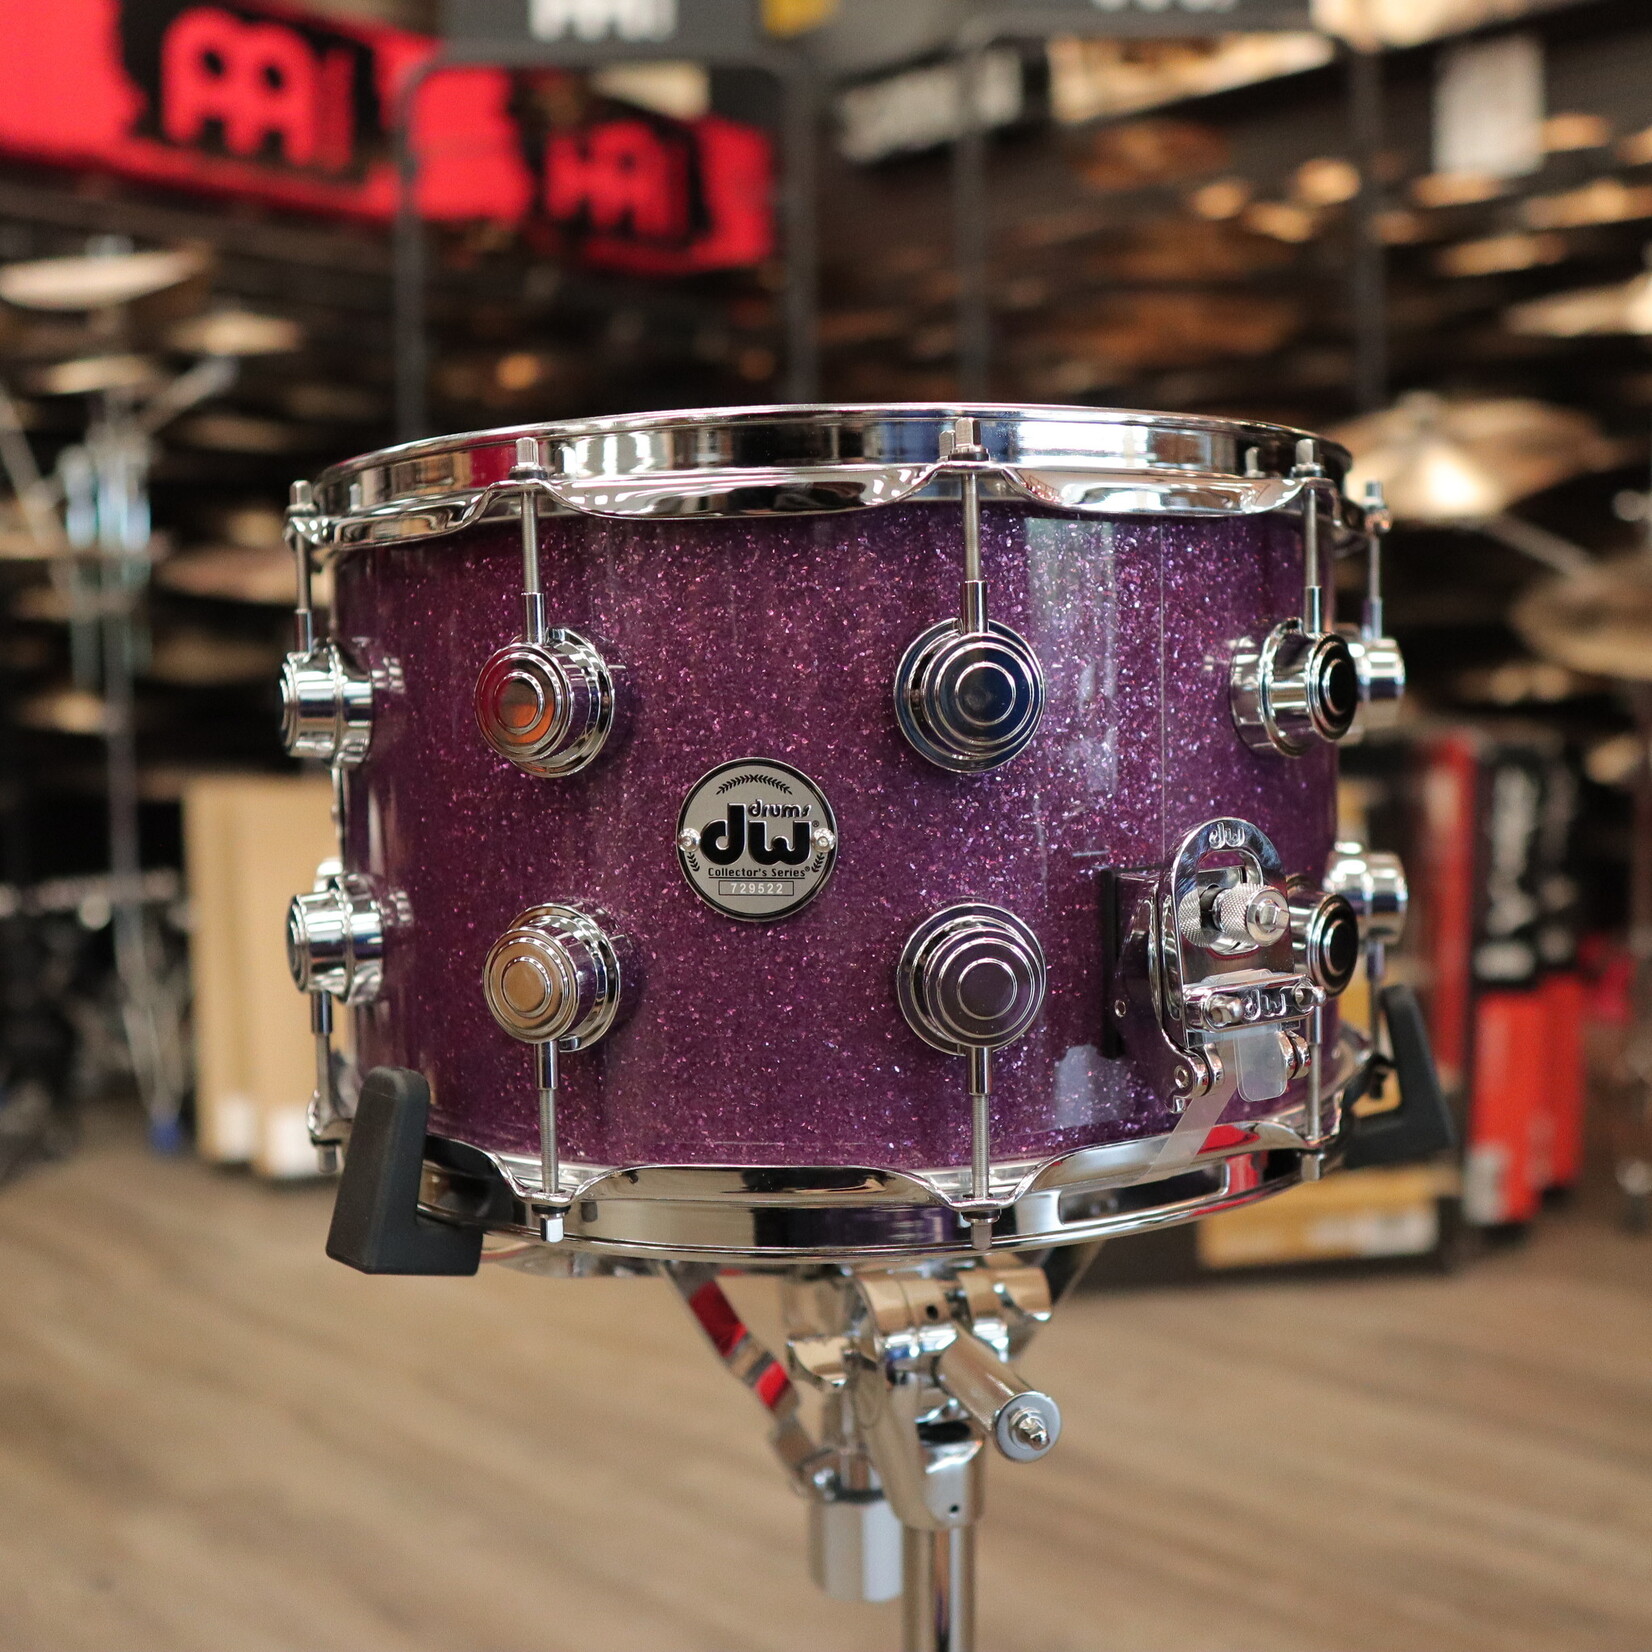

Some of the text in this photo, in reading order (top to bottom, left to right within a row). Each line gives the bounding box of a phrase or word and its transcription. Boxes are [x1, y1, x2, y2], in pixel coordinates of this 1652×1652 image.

[749, 799, 812, 819] drums
[700, 803, 812, 866] dw
[708, 867, 768, 877] Collector's
[730, 883, 784, 894] 729522
